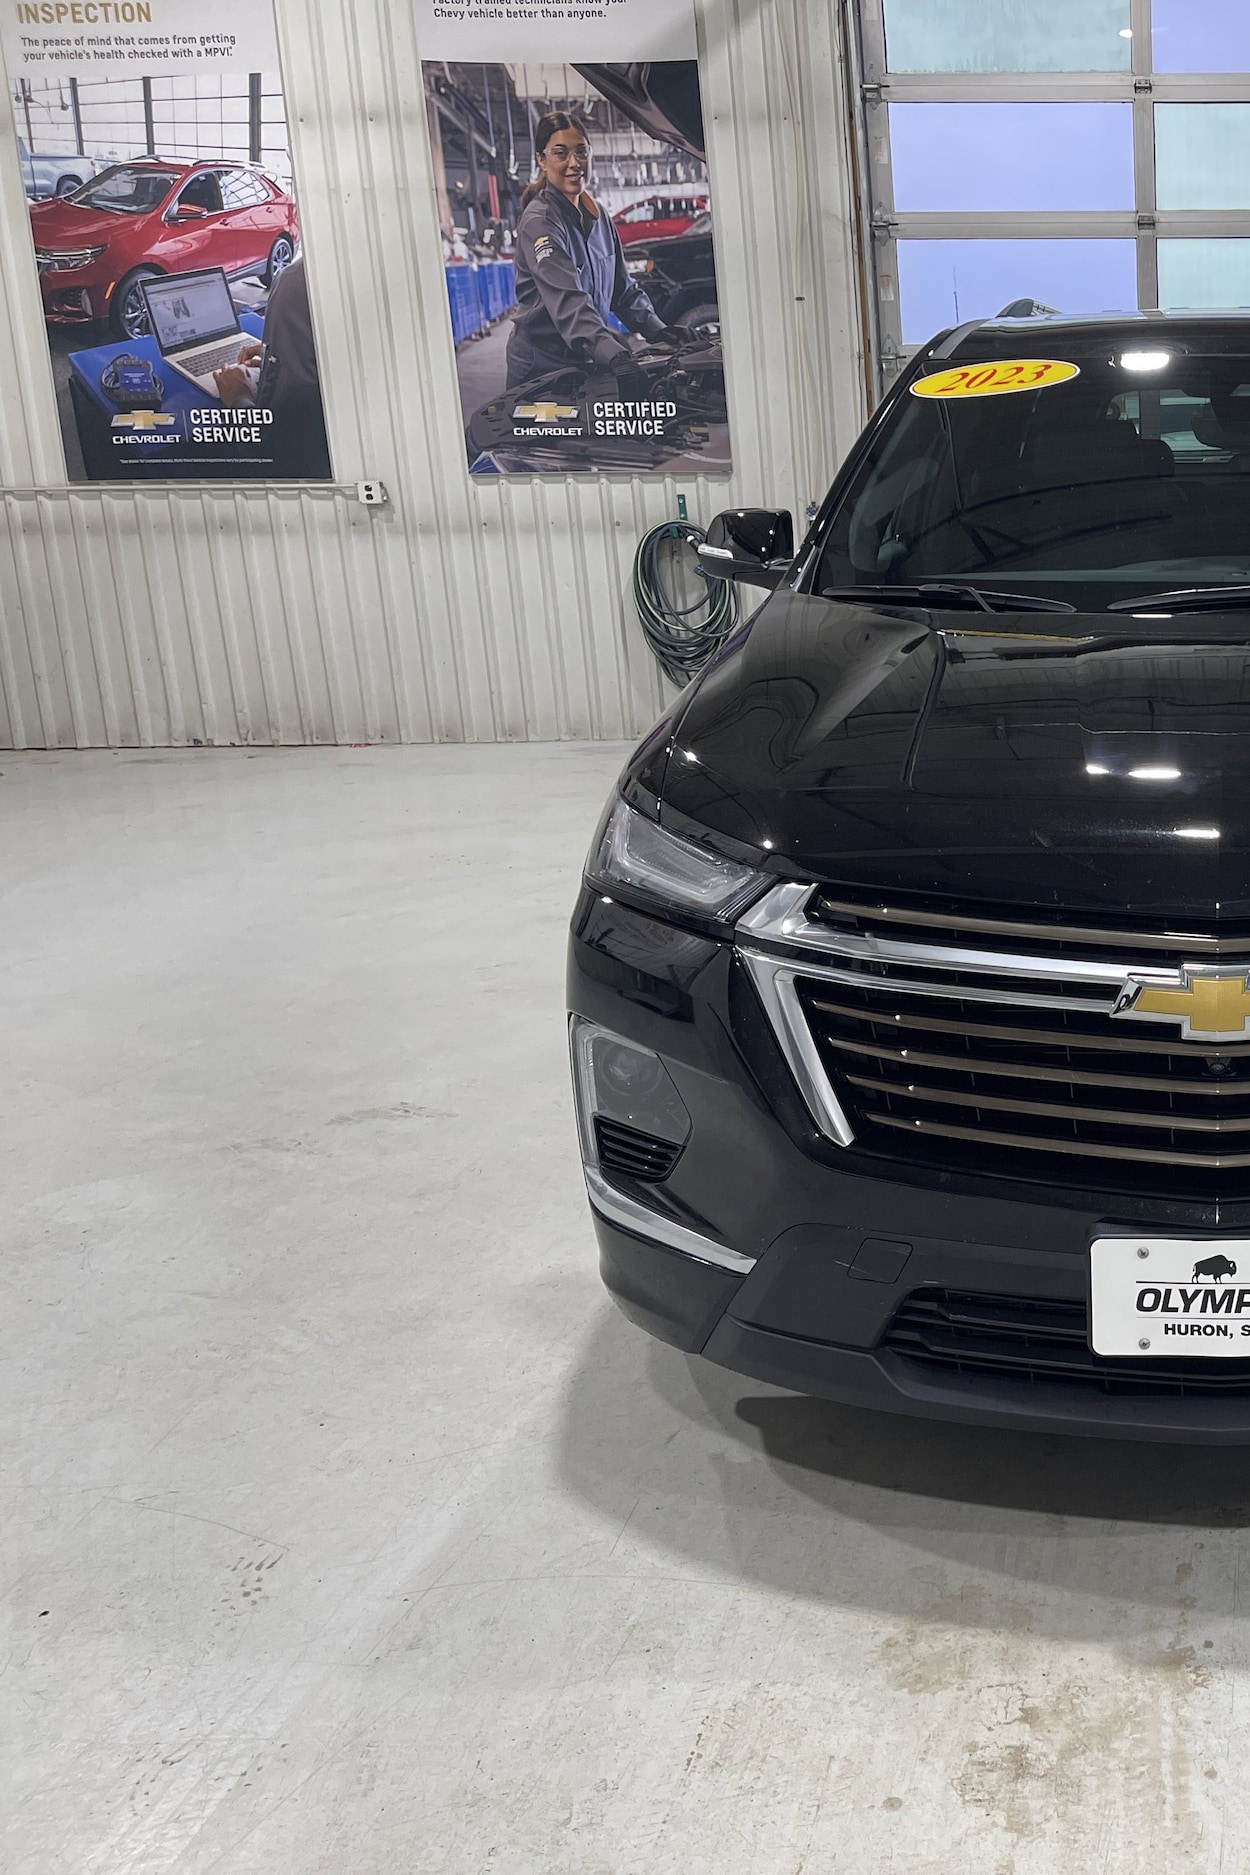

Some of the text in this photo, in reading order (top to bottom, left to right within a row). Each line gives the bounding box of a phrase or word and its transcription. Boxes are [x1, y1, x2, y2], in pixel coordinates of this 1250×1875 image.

[16, 2, 152, 24] INSPECTION
[433, 8, 607, 20] Chevy vehicle better than anyone.
[20, 33, 236, 49] The peace of mind that comes from getting
[23, 51, 46, 63] your
[48, 50, 91, 61] vehicle's
[93, 49, 126, 60] health
[128, 48, 169, 59] checked
[171, 48, 194, 58] with
[196, 50, 202, 58] a
[935, 364, 1053, 394] 2023
[190, 408, 274, 425] CERTIFIED
[593, 401, 677, 418] CERTIFIED
[192, 427, 262, 443] SERVICE
[513, 427, 583, 436] CHEVROLET
[595, 420, 664, 436] SERVICE
[112, 434, 181, 444] CHEVROLET
[1163, 1323, 1234, 1340] HURON,
